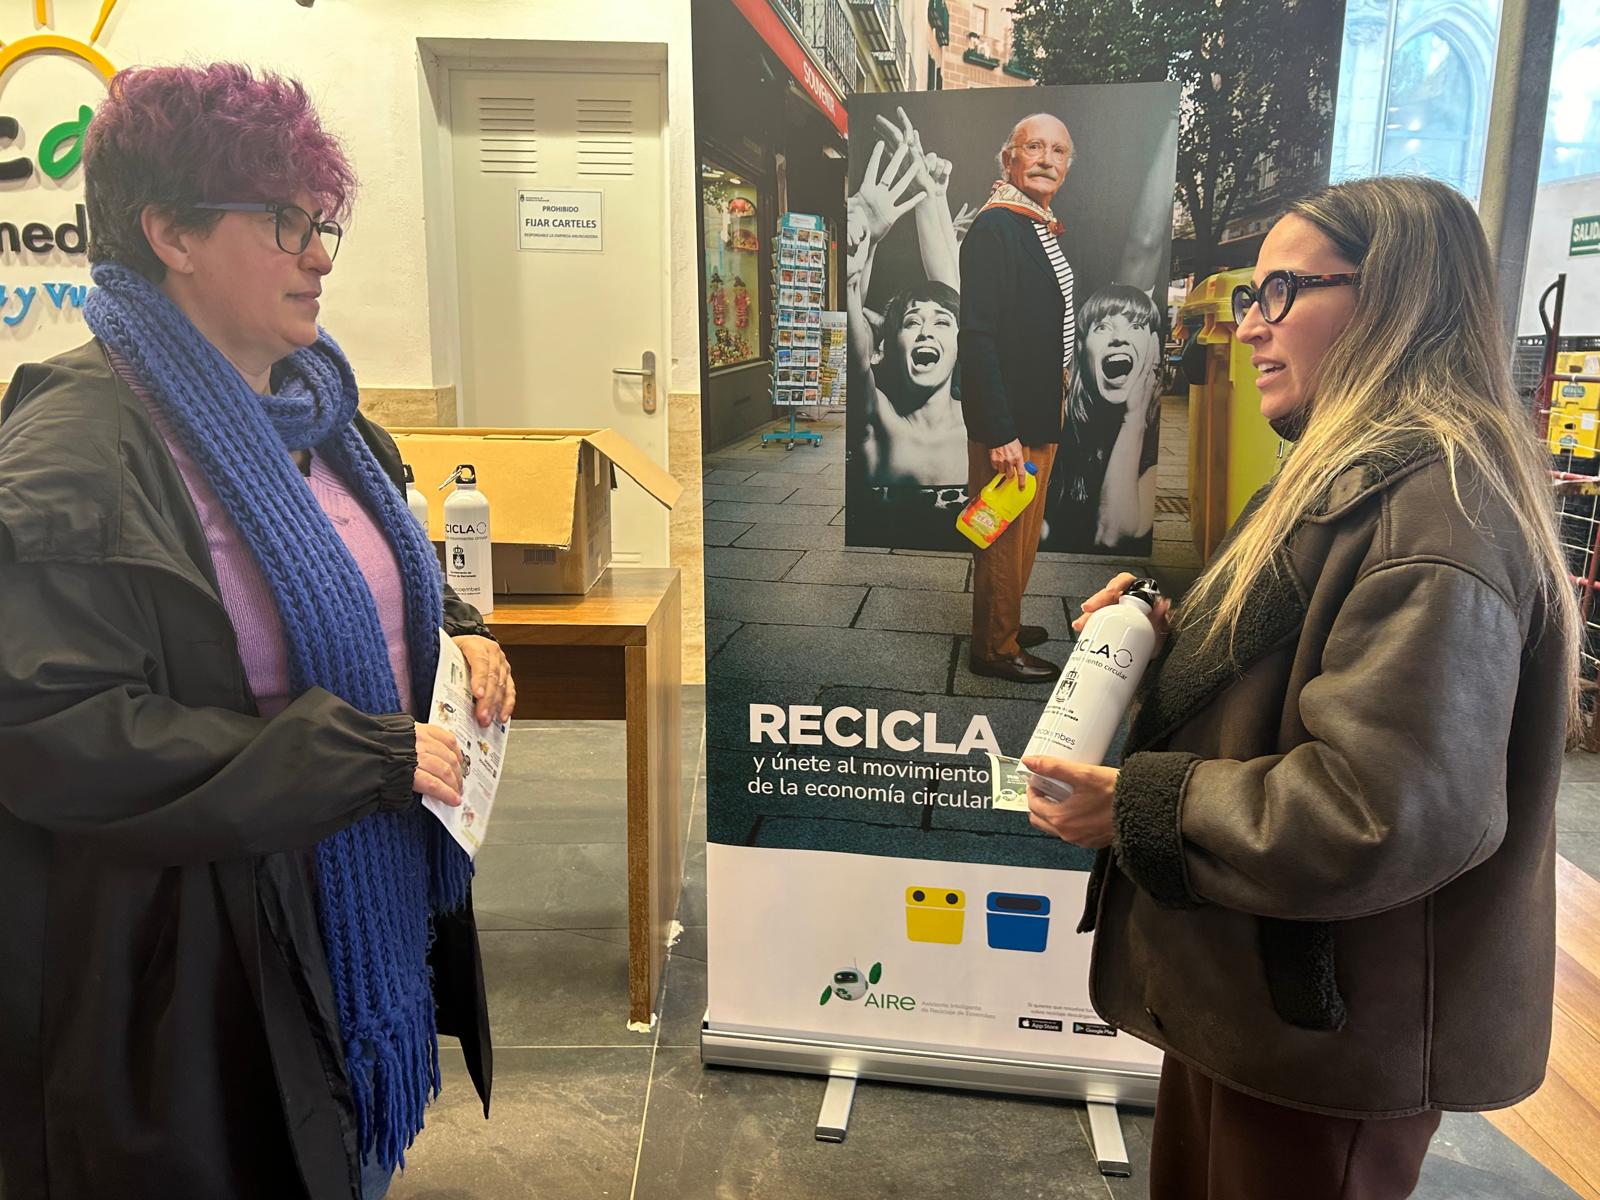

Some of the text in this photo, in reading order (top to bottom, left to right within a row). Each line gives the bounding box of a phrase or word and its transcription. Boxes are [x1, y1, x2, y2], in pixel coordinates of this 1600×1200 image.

[542, 205, 579, 213] PROHIBIDO
[525, 218, 597, 229] FIJAR CARTELES
[1572, 221, 1600, 242] SALID
[1103, 664, 1128, 681] circular
[749, 703, 1003, 755] RECICLA
[752, 755, 766, 773] y
[771, 751, 831, 773] únete
[837, 756, 857, 774] al
[862, 761, 990, 784] movimiento
[747, 776, 992, 809] de la economía circular
[1031, 1022, 1042, 1030] App
[1041, 1023, 1060, 1031] Store
[1085, 1027, 1104, 1035] Google
